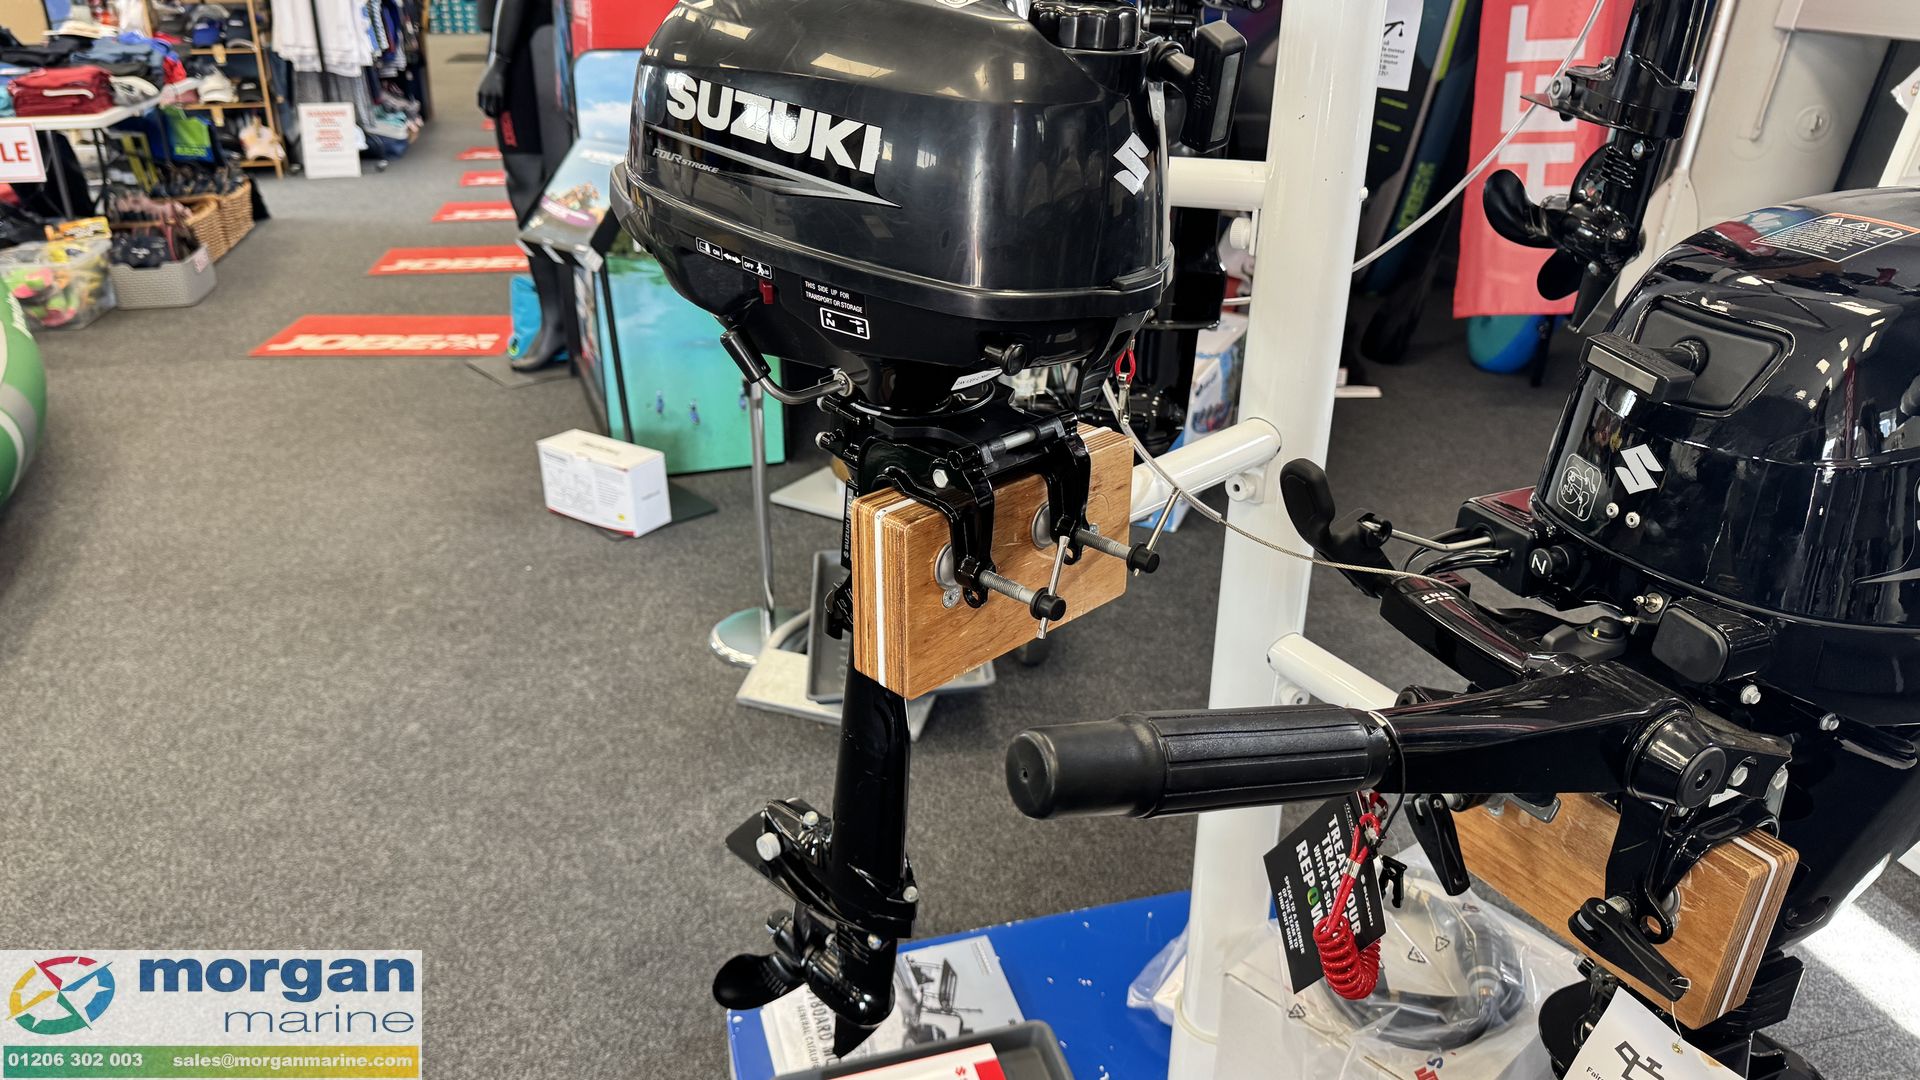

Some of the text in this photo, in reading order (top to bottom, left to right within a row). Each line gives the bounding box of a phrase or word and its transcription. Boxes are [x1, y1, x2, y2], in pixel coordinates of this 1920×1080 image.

[666, 72, 882, 175] SUZUKI
[652, 149, 682, 163] FOUR
[804, 280, 816, 290] THIS
[818, 284, 828, 294] SIDE
[840, 291, 850, 300] FOR
[806, 290, 832, 304] TRANSPORT
[840, 302, 862, 314] STORAGE
[826, 318, 864, 334] N F
[267, 334, 446, 351] JOBE
[1532, 554, 1546, 574] N
[1314, 844, 1326, 878] WITH
[1321, 880, 1328, 890] A
[1284, 876, 1294, 900] SPEAK
[1290, 901, 1296, 912] TO
[1294, 920, 1305, 954] MEMBER
[1363, 886, 1374, 926] SUZUKI
[1282, 888, 1287, 898] OF
[1293, 937, 1298, 948] TO
[1286, 927, 1294, 950] MORE
